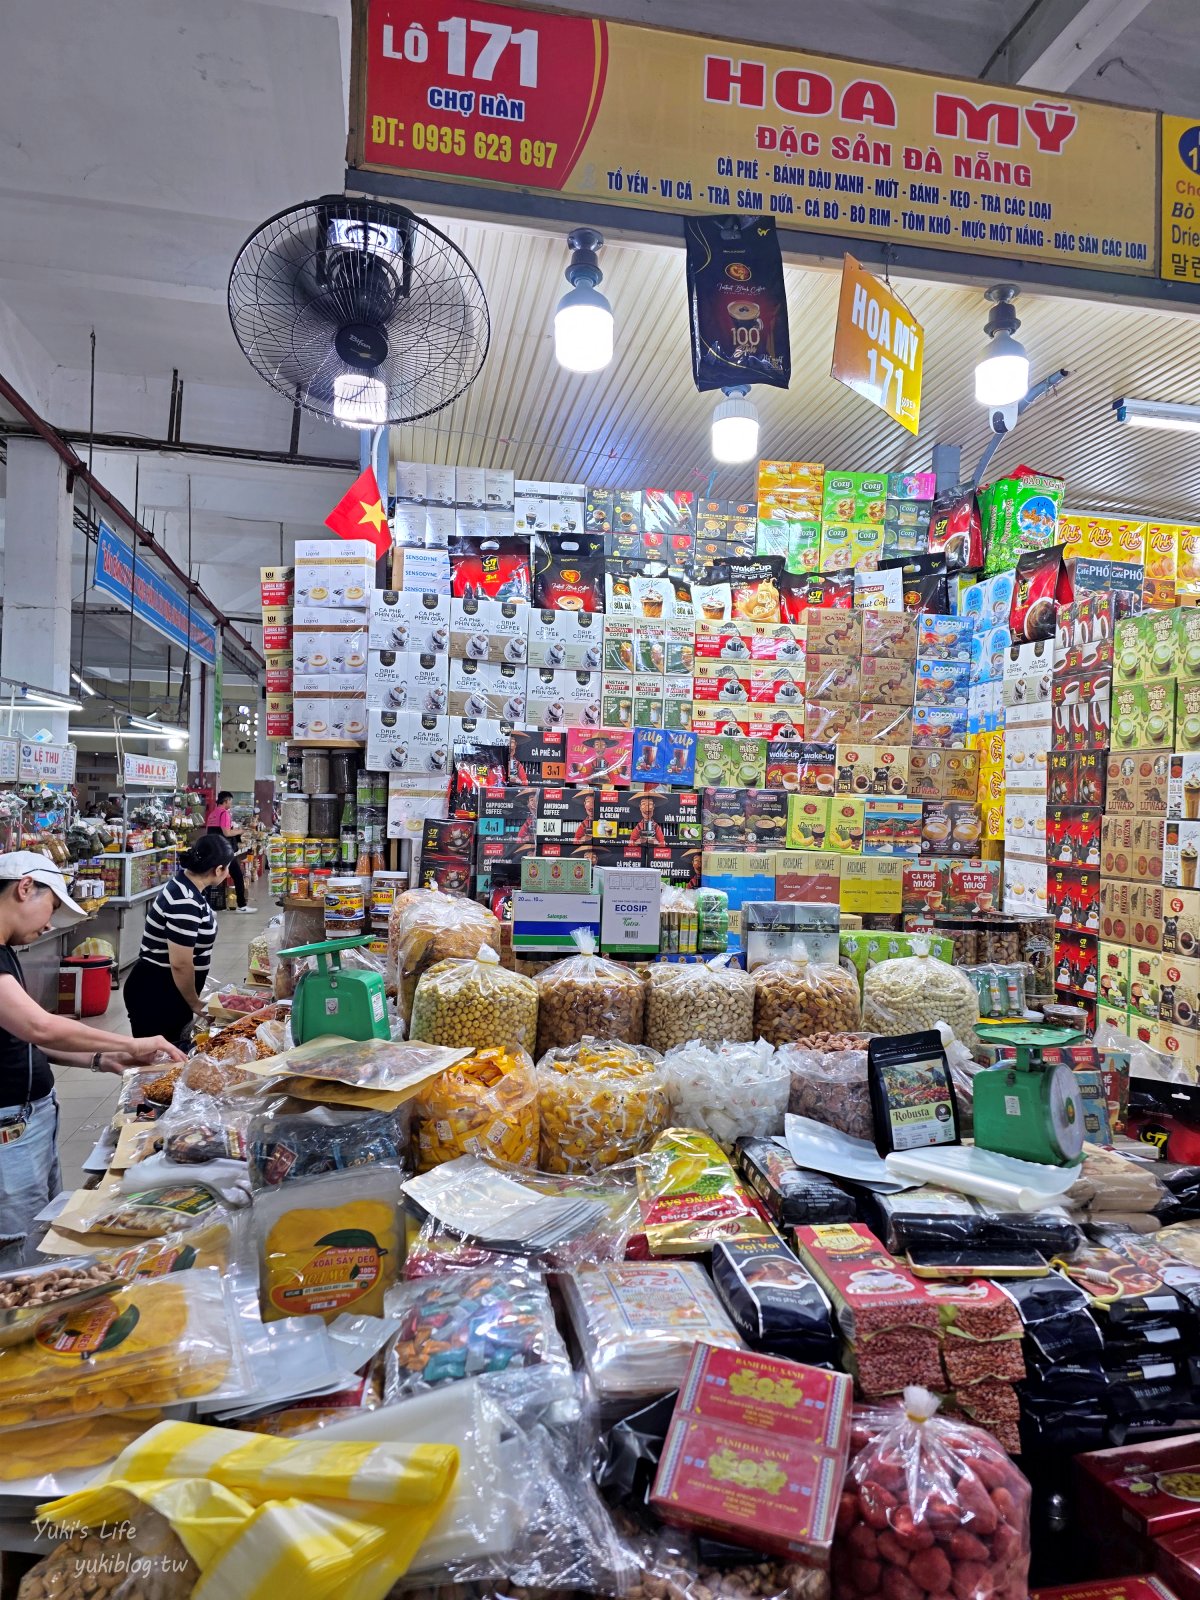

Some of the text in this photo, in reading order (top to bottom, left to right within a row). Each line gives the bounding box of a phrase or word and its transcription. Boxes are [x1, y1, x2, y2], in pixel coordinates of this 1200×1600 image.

[382, 16, 539, 89] LÔ 171
[429, 88, 525, 121] CHỢ HÀN
[704, 54, 1078, 155] HOA MỸ
[372, 116, 558, 169] ĐT: 0935 623 897
[756, 124, 1032, 189] ĐẶC SẢN ĐÀ NẴNG
[717, 156, 1051, 220] CÀ PHÊ BÁNH ĐẬU XANH MỨT BÁNH KẸO TRÀ CÁC LOẠI
[607, 165, 623, 191] TỔ
[627, 169, 648, 195] YẾN
[660, 179, 673, 198] VI
[676, 180, 693, 200] CÁ
[707, 185, 730, 206] TRÀ
[737, 188, 763, 210] SÂM
[804, 197, 821, 218] CÁ
[823, 200, 839, 220] BÒ
[850, 203, 866, 224] BÒ
[869, 207, 891, 228] RIM
[902, 210, 926, 232] TÔM
[929, 214, 951, 236] KHÔ
[962, 220, 987, 242] MỰC
[989, 224, 1013, 244] MỘT
[1015, 224, 1044, 247] NẮNG
[1054, 231, 1076, 253] ĐẶC
[1101, 238, 1122, 258] CÁC
[1125, 241, 1148, 263] LOẠI
[852, 283, 919, 371] HOA MỸ
[731, 326, 761, 346] 100
[867, 349, 905, 416] 171
[832, 479, 881, 491] Cozy Cozy
[828, 529, 846, 538] Cozy
[859, 530, 877, 540] Cozy
[405, 554, 437, 562] SENSODYNE
[405, 570, 437, 578] SENSODYNE
[404, 585, 437, 594] SENSODYNE
[937, 620, 970, 629] COCONUT
[934, 666, 966, 675] COCONUT
[930, 711, 963, 720] COCONUT
[45, 751, 60, 764] THU
[769, 751, 834, 761] wake-up wake-up
[600, 806, 614, 814] BLACK
[543, 822, 556, 833] BLACK
[671, 869, 690, 877] COFFEE
[912, 872, 921, 880] CÀ
[923, 872, 937, 880] PHÊ
[973, 874, 987, 882] PHÊ
[615, 904, 647, 912] ECOSIP
[893, 1108, 930, 1121] Robusta
[1140, 1128, 1168, 1148] G7
